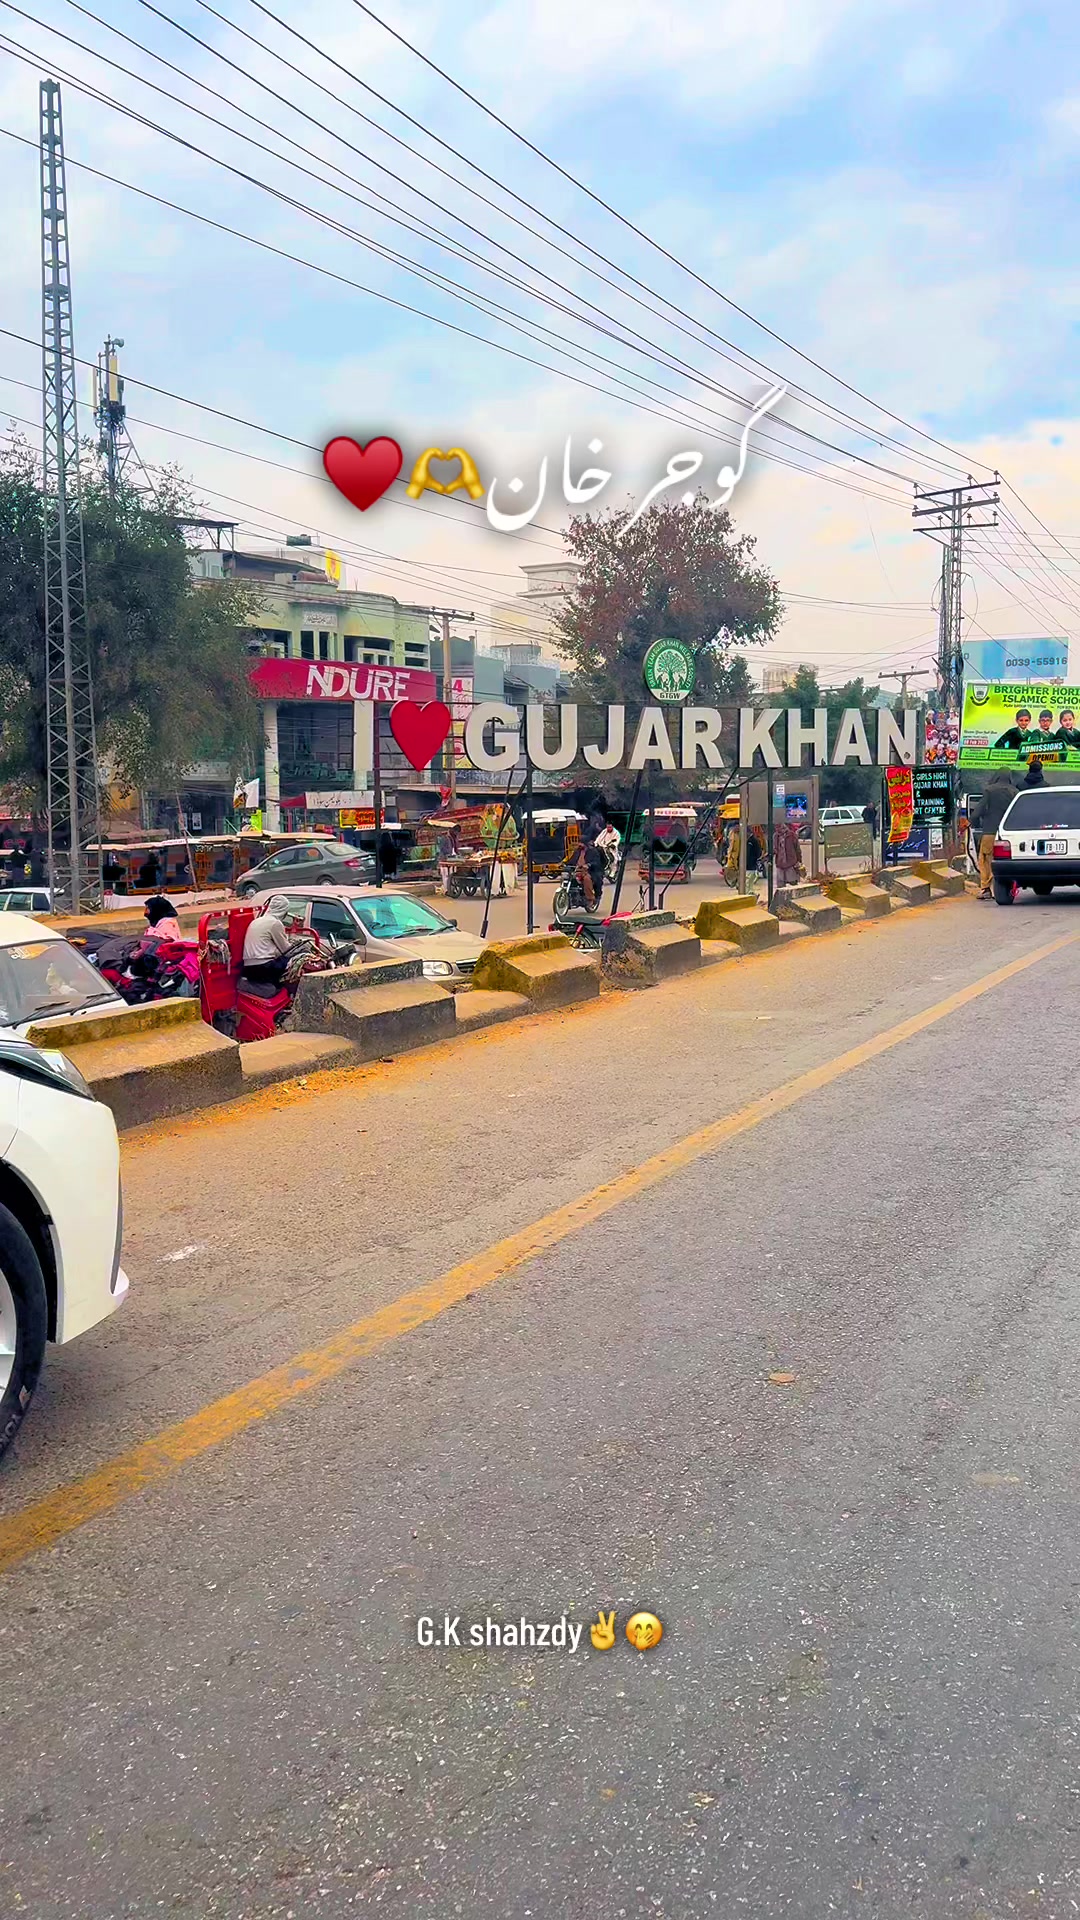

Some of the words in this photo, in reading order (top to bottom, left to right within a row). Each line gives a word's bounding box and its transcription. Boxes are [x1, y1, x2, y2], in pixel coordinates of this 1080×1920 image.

[306, 664, 411, 701] NDURE
[994, 685, 1050, 695] BRIGHTER
[1002, 694, 1048, 704] ISLAMIC
[1050, 696, 1080, 705] SCHO
[353, 701, 374, 771] I
[465, 701, 725, 772] GUJAR
[738, 708, 917, 768] KHAN
[1021, 742, 1063, 753] ADMISSIONS
